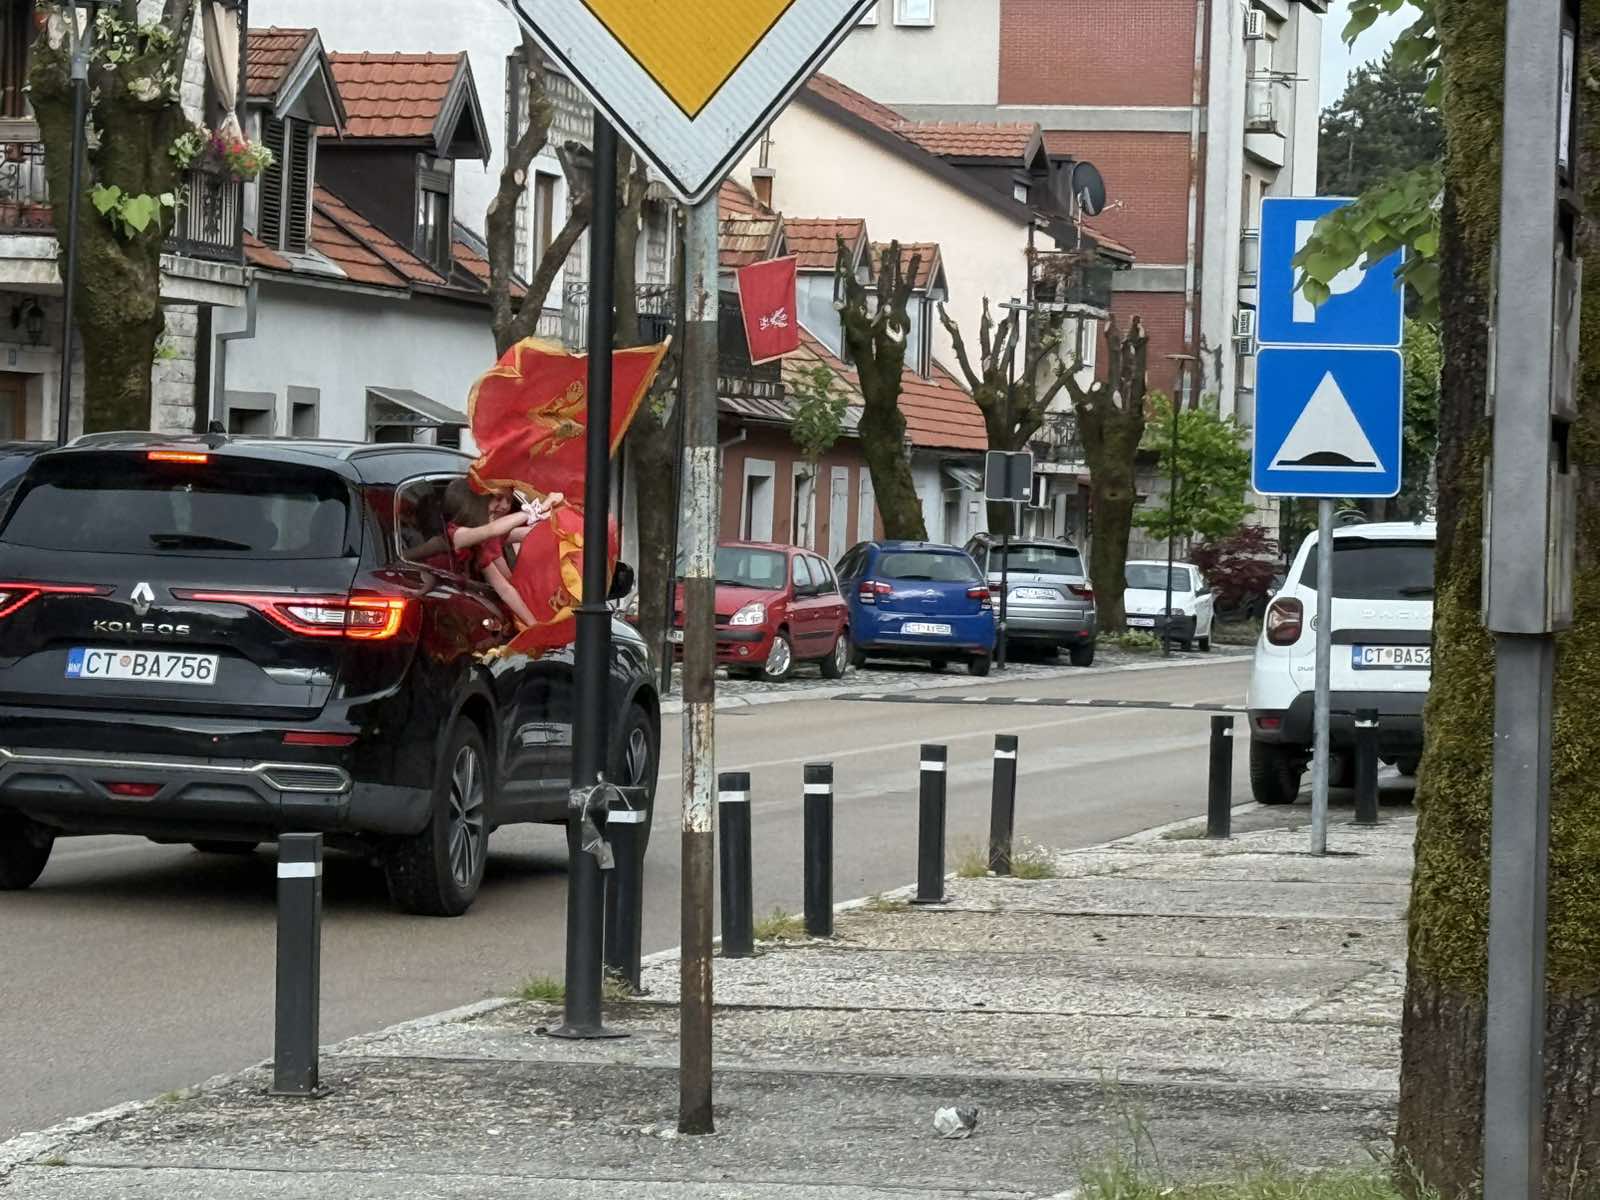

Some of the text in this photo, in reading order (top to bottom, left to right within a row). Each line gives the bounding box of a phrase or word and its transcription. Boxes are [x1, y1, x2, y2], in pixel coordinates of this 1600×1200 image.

[93, 620, 191, 635] KOLEOS
[1364, 648, 1385, 663] CT
[86, 652, 212, 679] CT BA756
